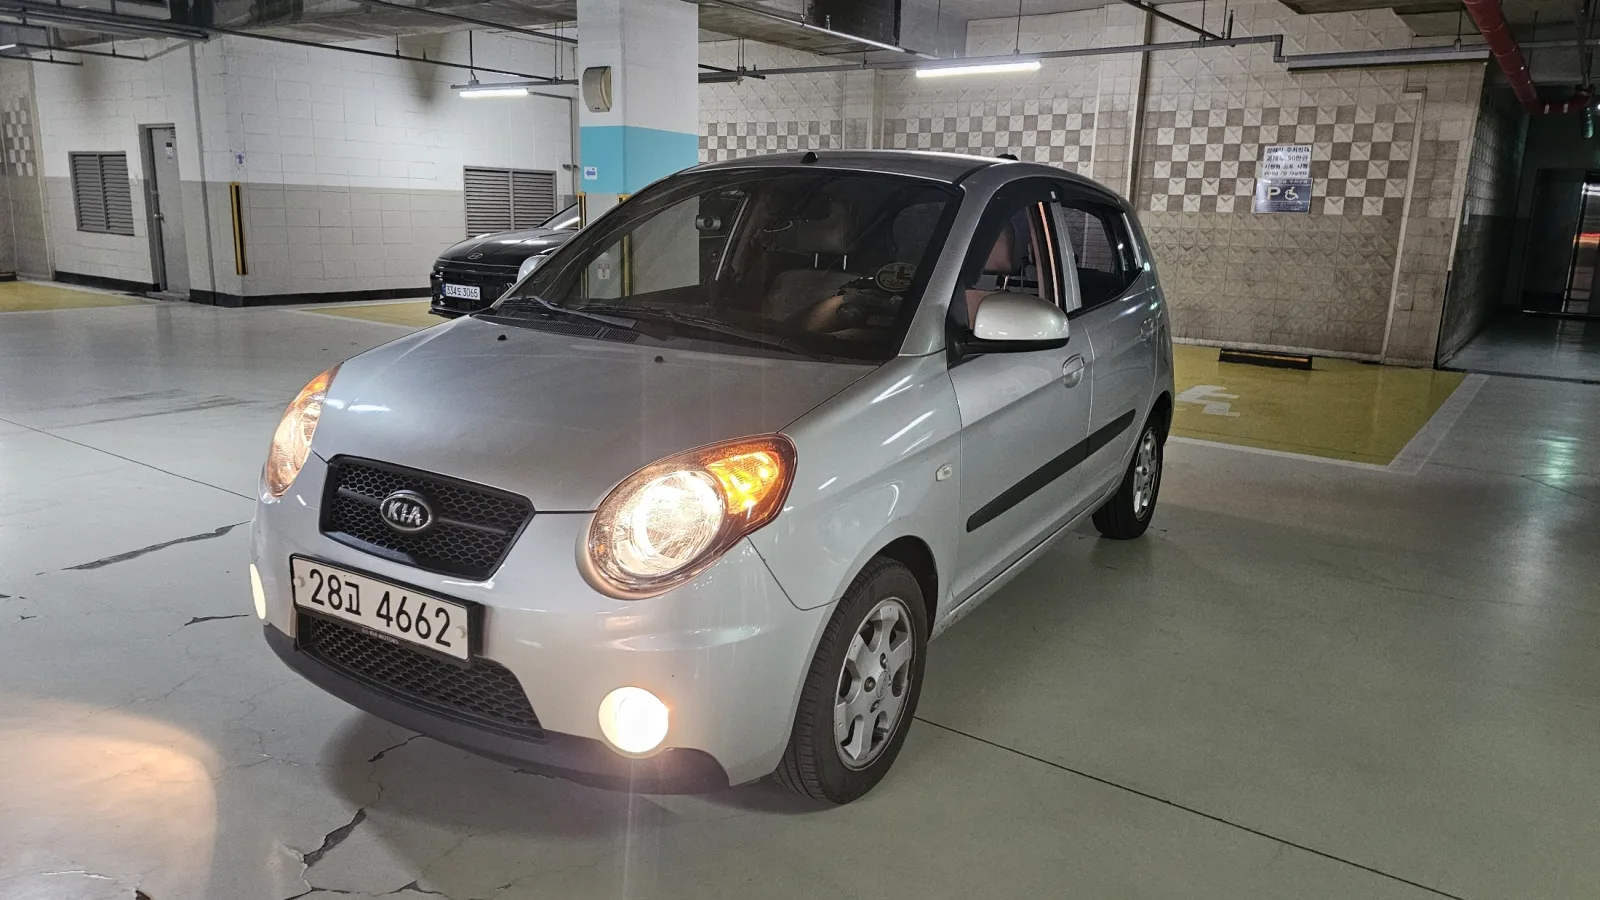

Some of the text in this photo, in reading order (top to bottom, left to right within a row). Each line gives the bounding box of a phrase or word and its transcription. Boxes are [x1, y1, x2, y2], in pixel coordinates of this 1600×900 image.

[1267, 187, 1281, 200] P
[463, 287, 478, 298] 3065
[387, 500, 422, 526] KIA
[309, 568, 451, 648] 28고 4662
